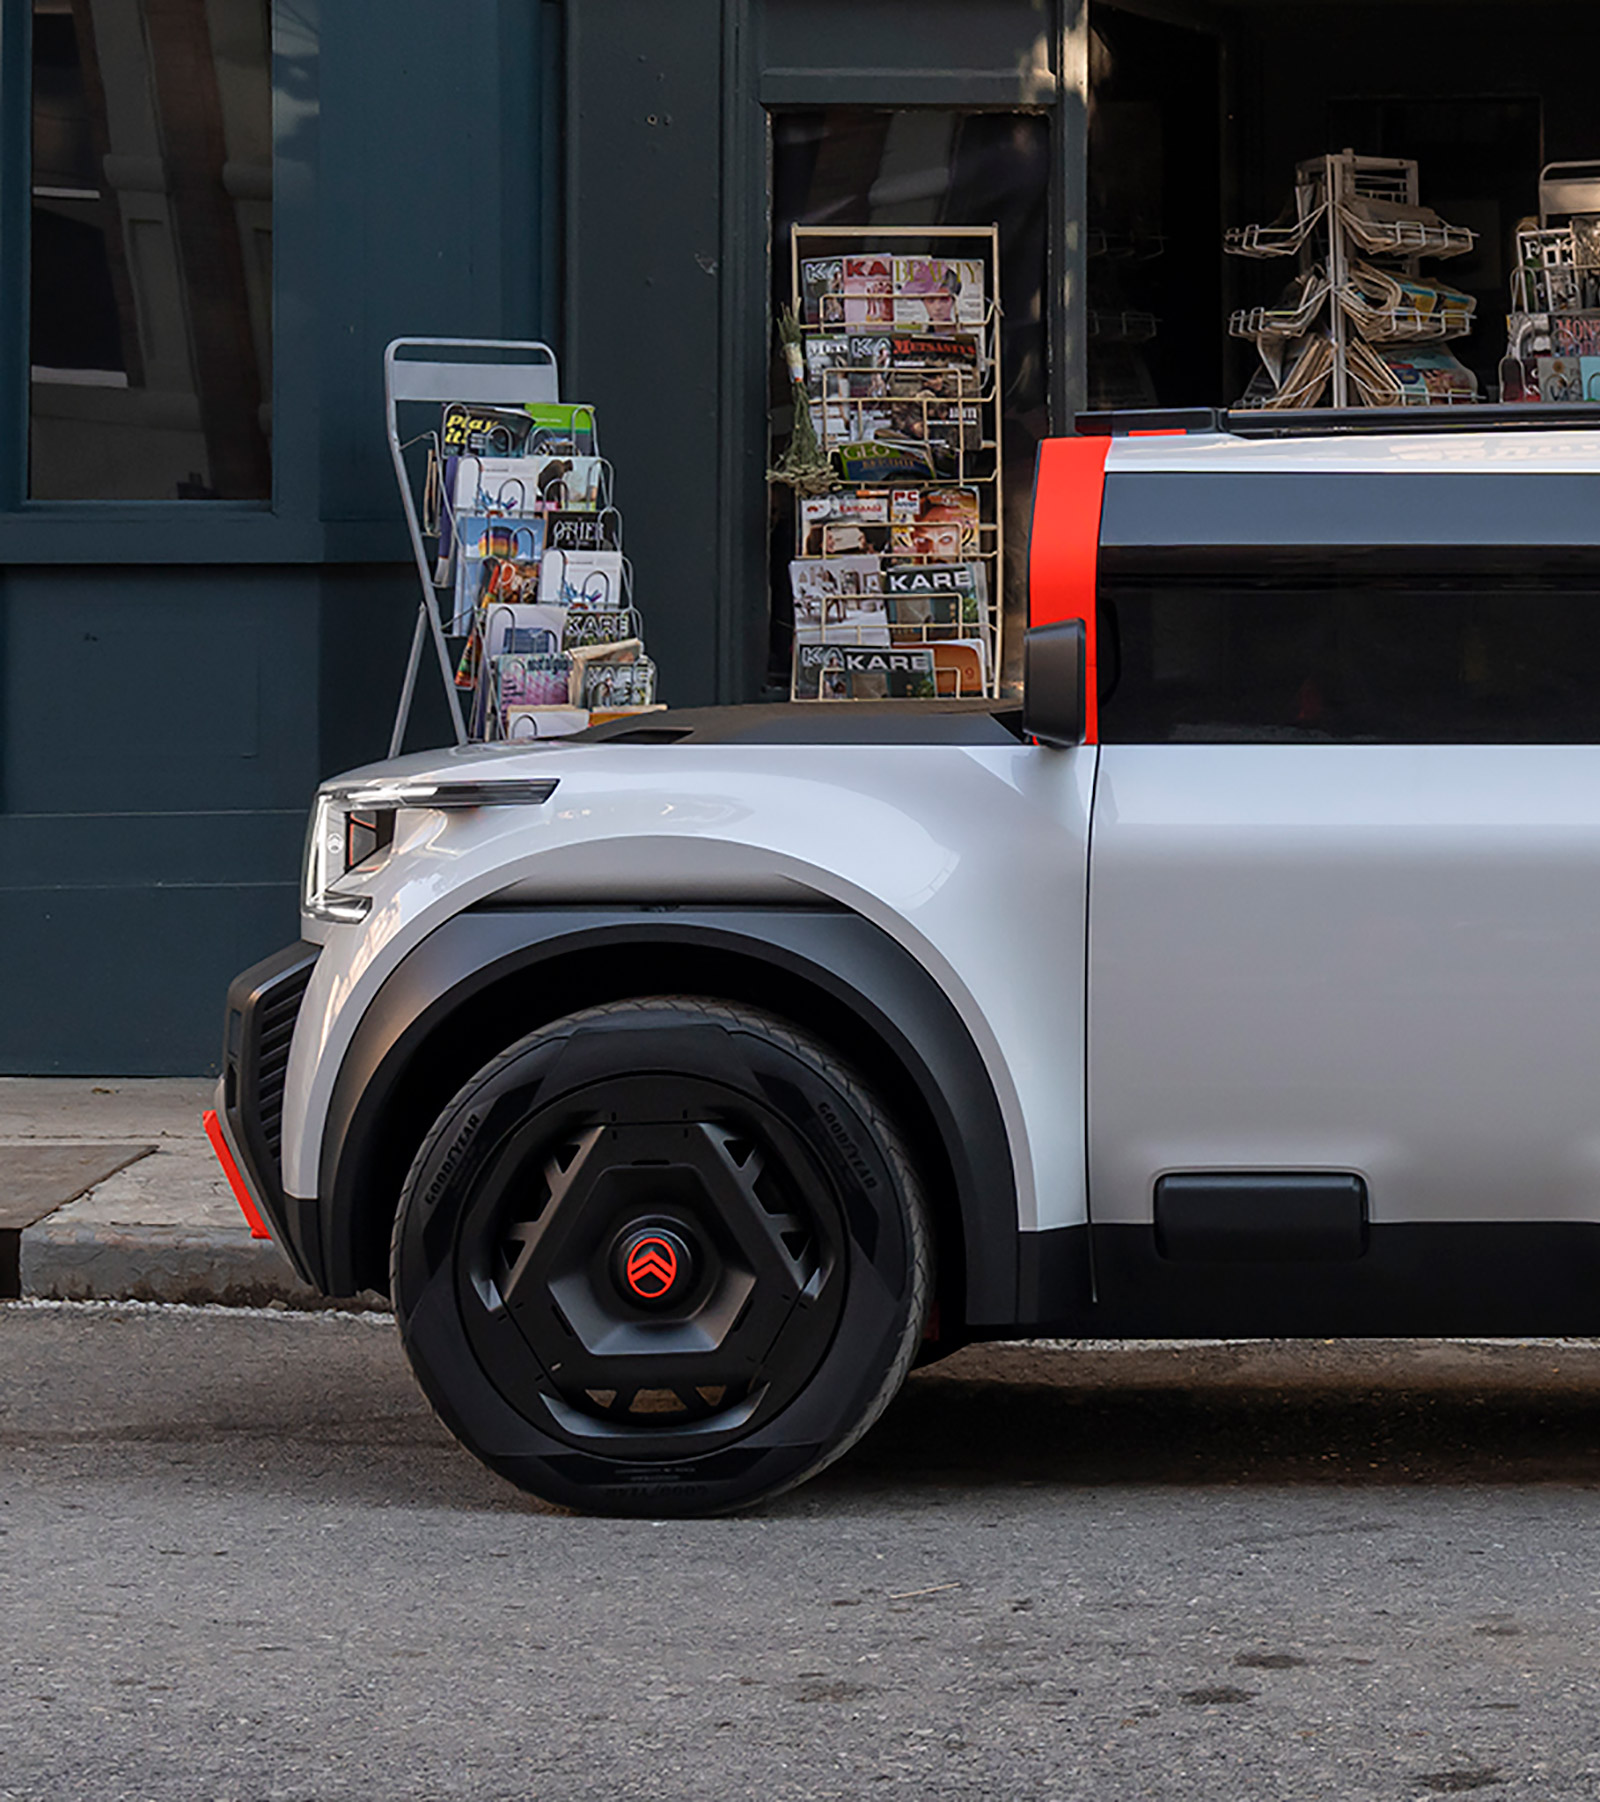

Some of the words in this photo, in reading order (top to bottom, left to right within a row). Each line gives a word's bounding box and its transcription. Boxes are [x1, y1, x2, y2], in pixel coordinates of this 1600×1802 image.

[894, 491, 918, 501] PC
[889, 570, 972, 592] KARE
[565, 615, 629, 637] KARE
[847, 655, 929, 671] KARE
[818, 1102, 878, 1190] GOODYEAR
[424, 1114, 480, 1206] GOODYEAR
